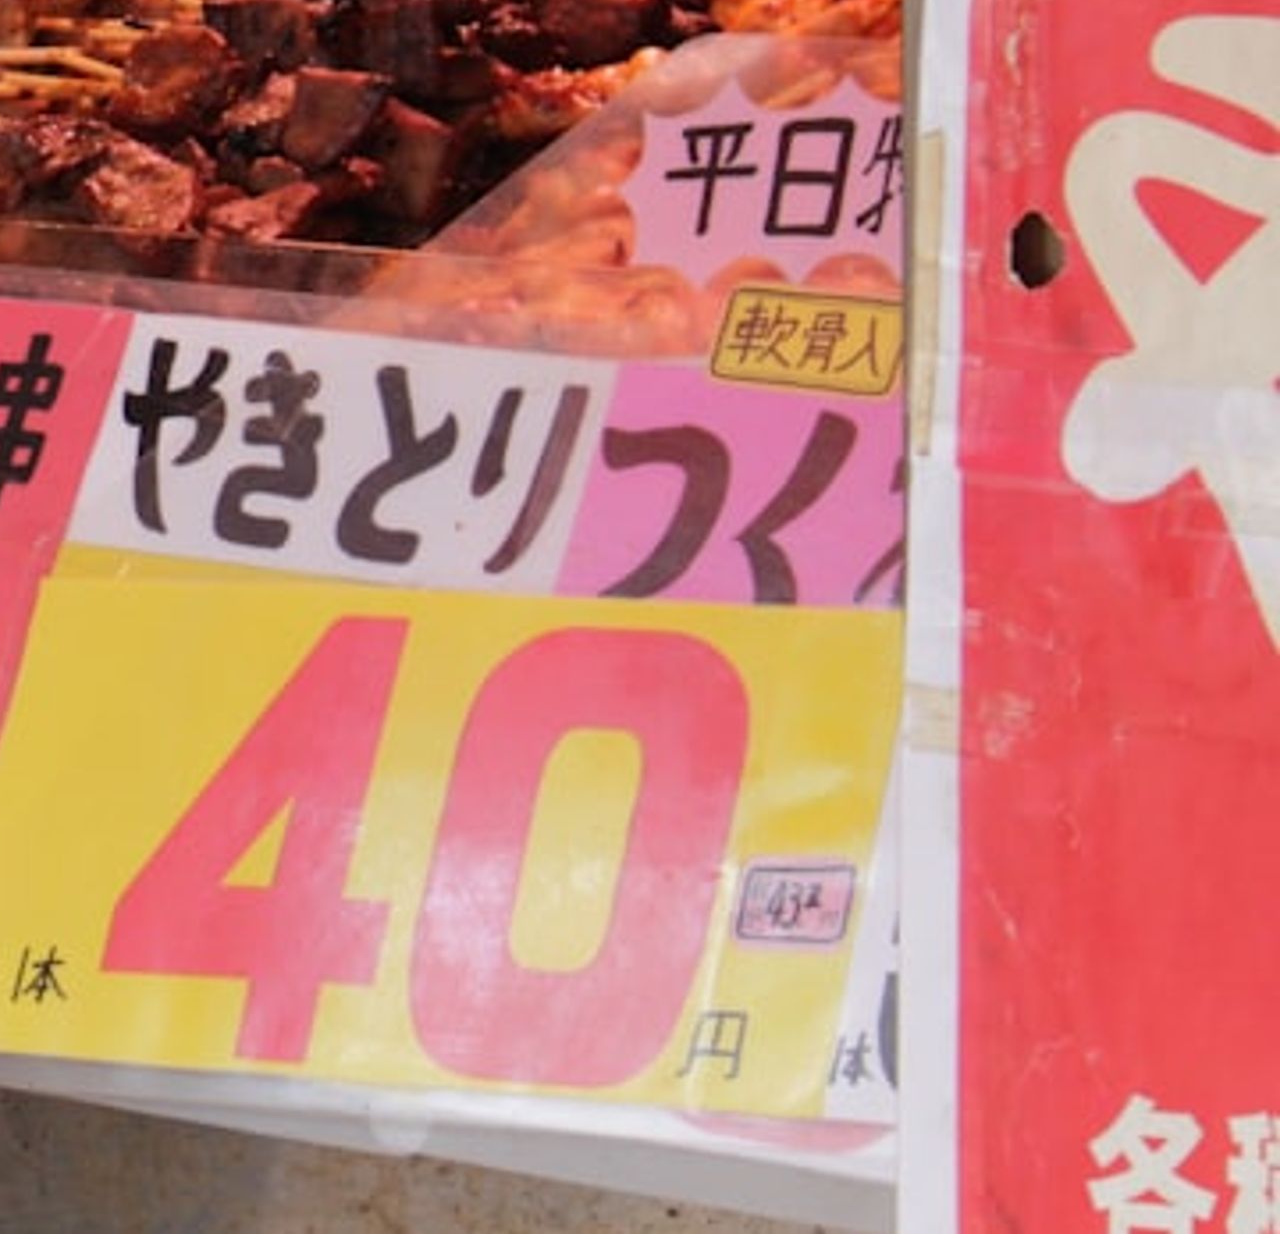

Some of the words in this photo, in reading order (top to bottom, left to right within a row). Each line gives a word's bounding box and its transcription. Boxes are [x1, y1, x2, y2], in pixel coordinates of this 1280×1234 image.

[122, 335, 590, 575] やきとり
[99, 613, 751, 1090] 40
[676, 1008, 748, 1082] 円
[1085, 1093, 1280, 1234] 各
